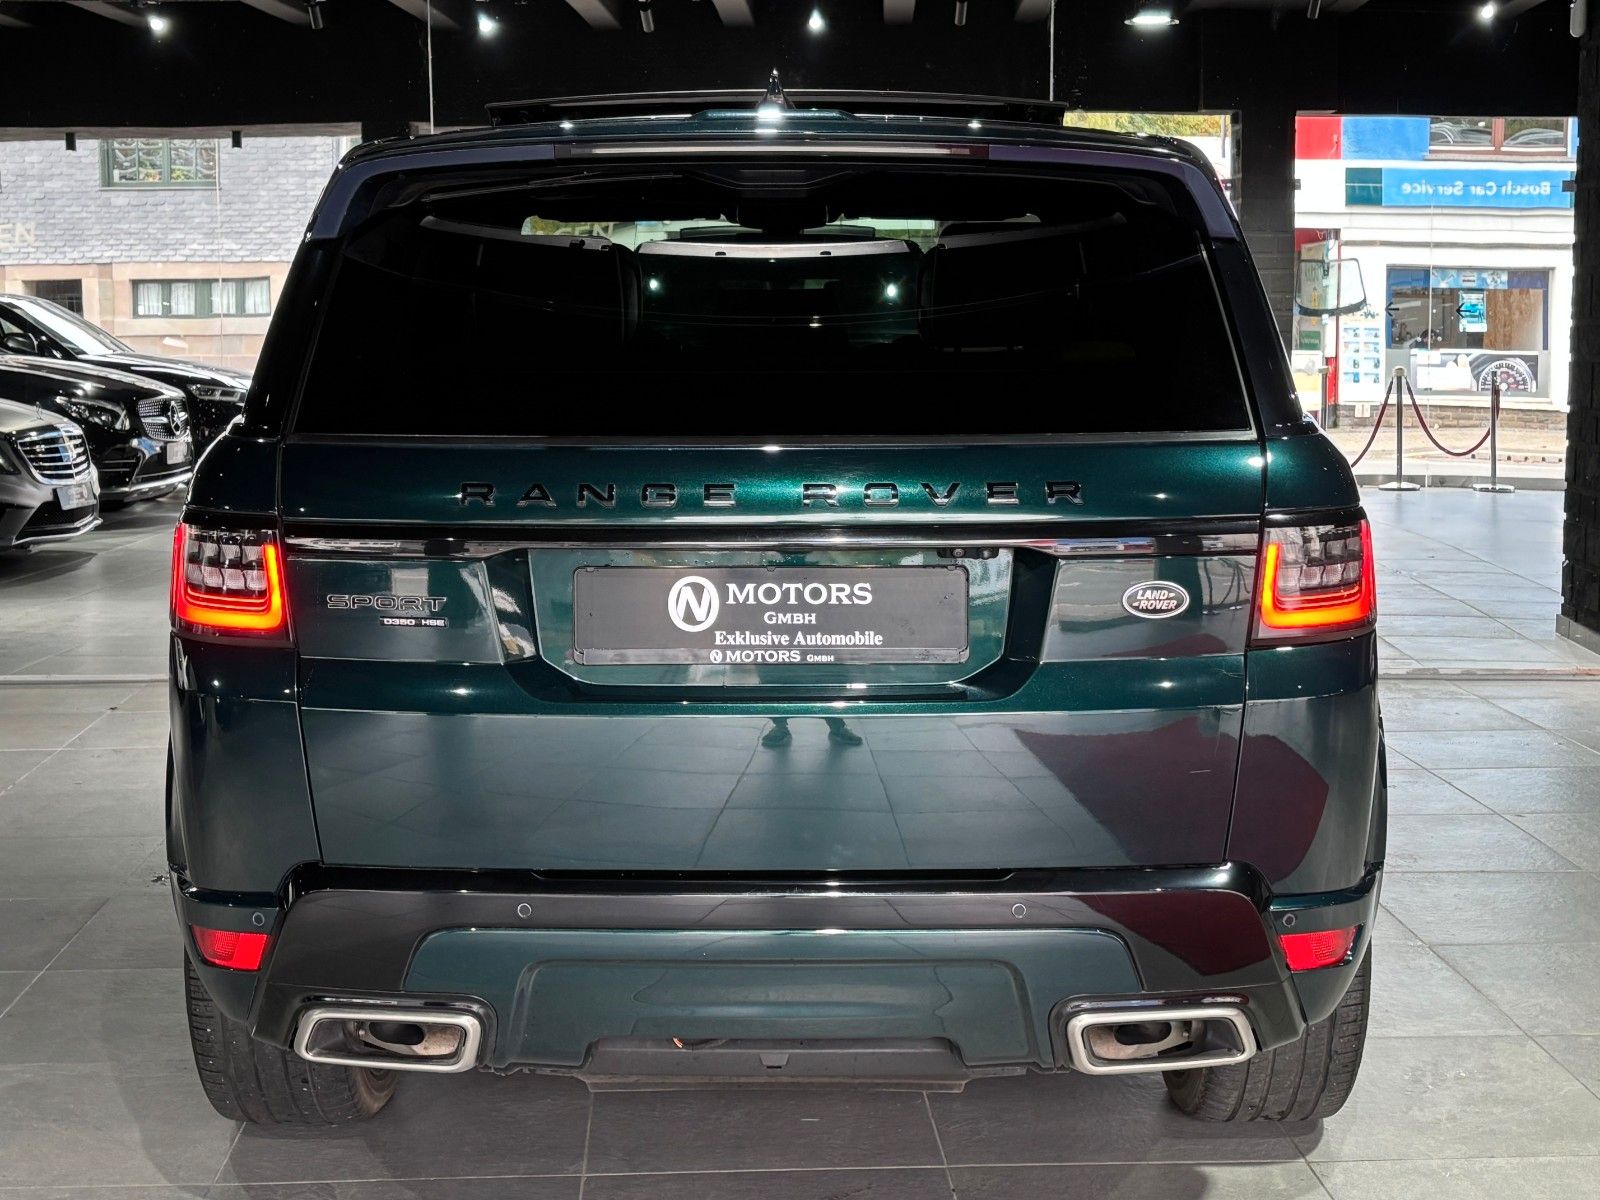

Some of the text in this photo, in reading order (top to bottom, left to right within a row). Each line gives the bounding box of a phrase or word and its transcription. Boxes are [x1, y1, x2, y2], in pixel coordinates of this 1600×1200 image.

[459, 480, 1085, 508] RANGE ROVER
[725, 582, 873, 605] MOTORS
[327, 594, 447, 612] SPORT
[1138, 600, 1178, 610] ROVER
[421, 619, 445, 627] HSE
[714, 630, 884, 646] Exklusive Automobile
[726, 649, 801, 663] MOTORS
